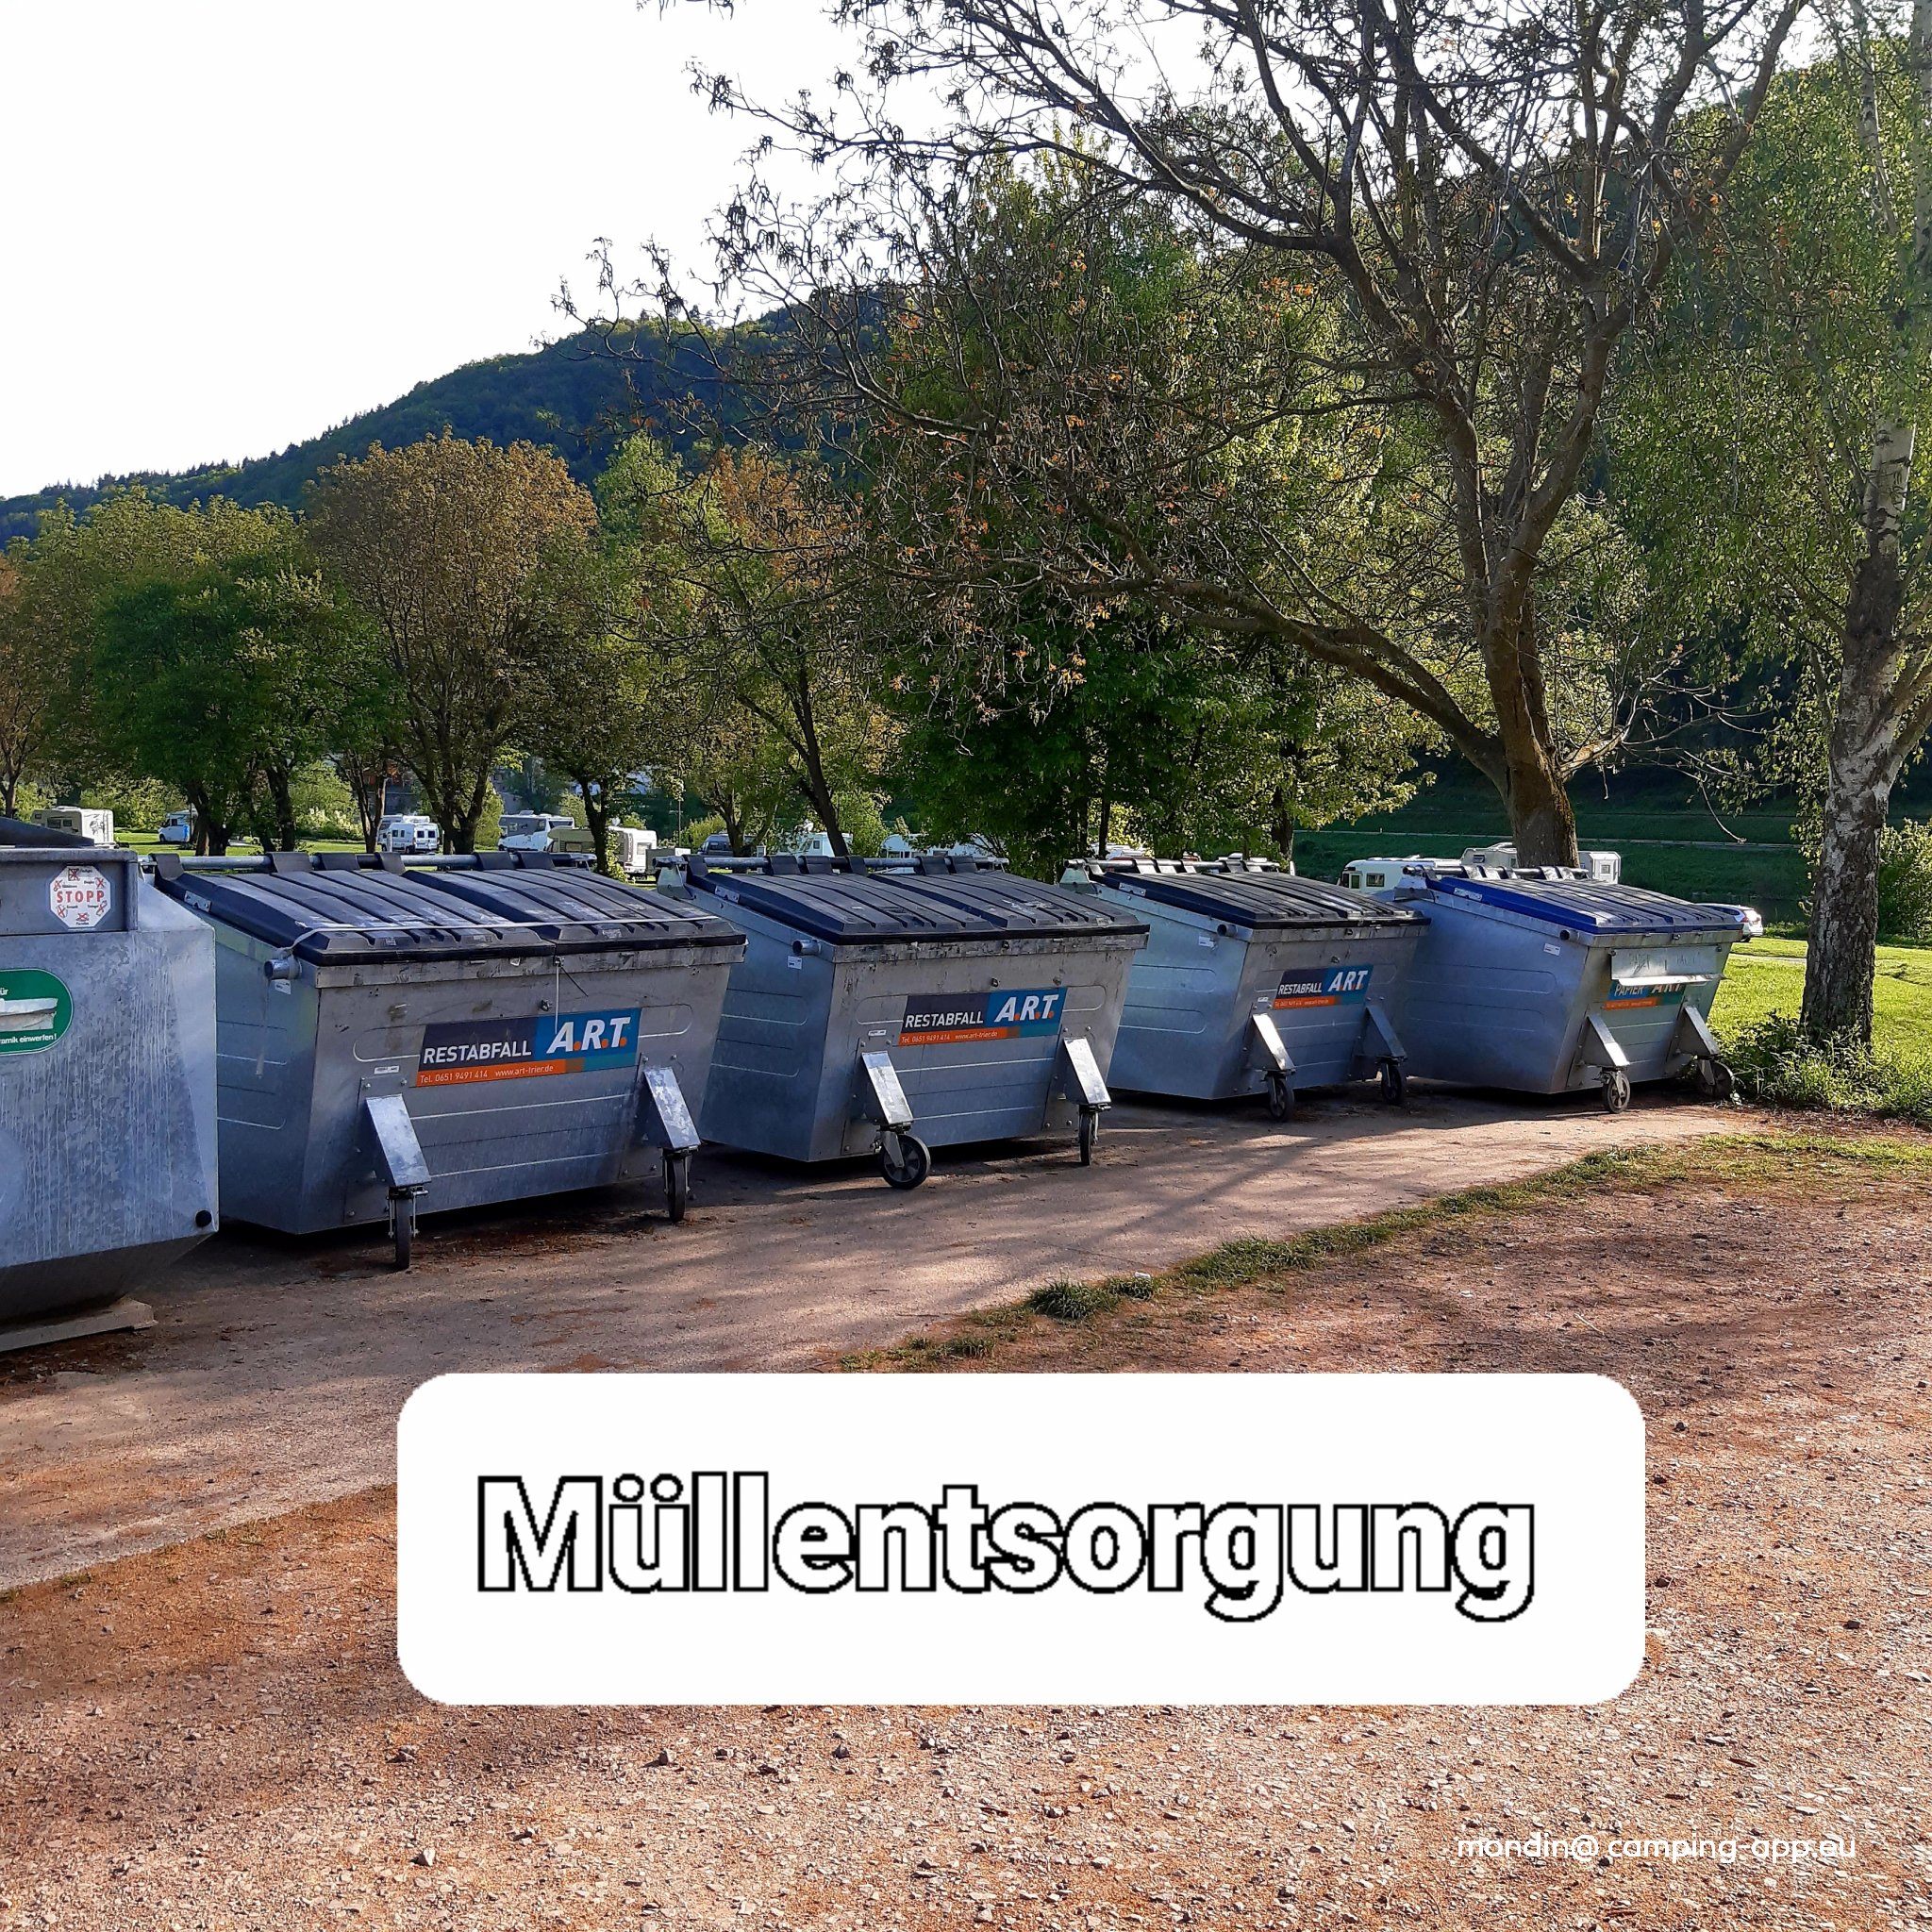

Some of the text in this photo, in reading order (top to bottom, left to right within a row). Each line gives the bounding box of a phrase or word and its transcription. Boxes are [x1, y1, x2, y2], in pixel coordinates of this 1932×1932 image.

[57, 891, 105, 903] STOPP
[0, 987, 8, 996] ür
[1278, 982, 1322, 995] RESTABFALL
[1614, 984, 1645, 996] PAPIER
[905, 1010, 984, 1028] RESTABFALL
[546, 1016, 631, 1054] A.R.T.
[424, 1040, 532, 1064] RESTABFALL
[421, 1064, 554, 1084] Tel. 0651 9491 414 www.art-trier.de
